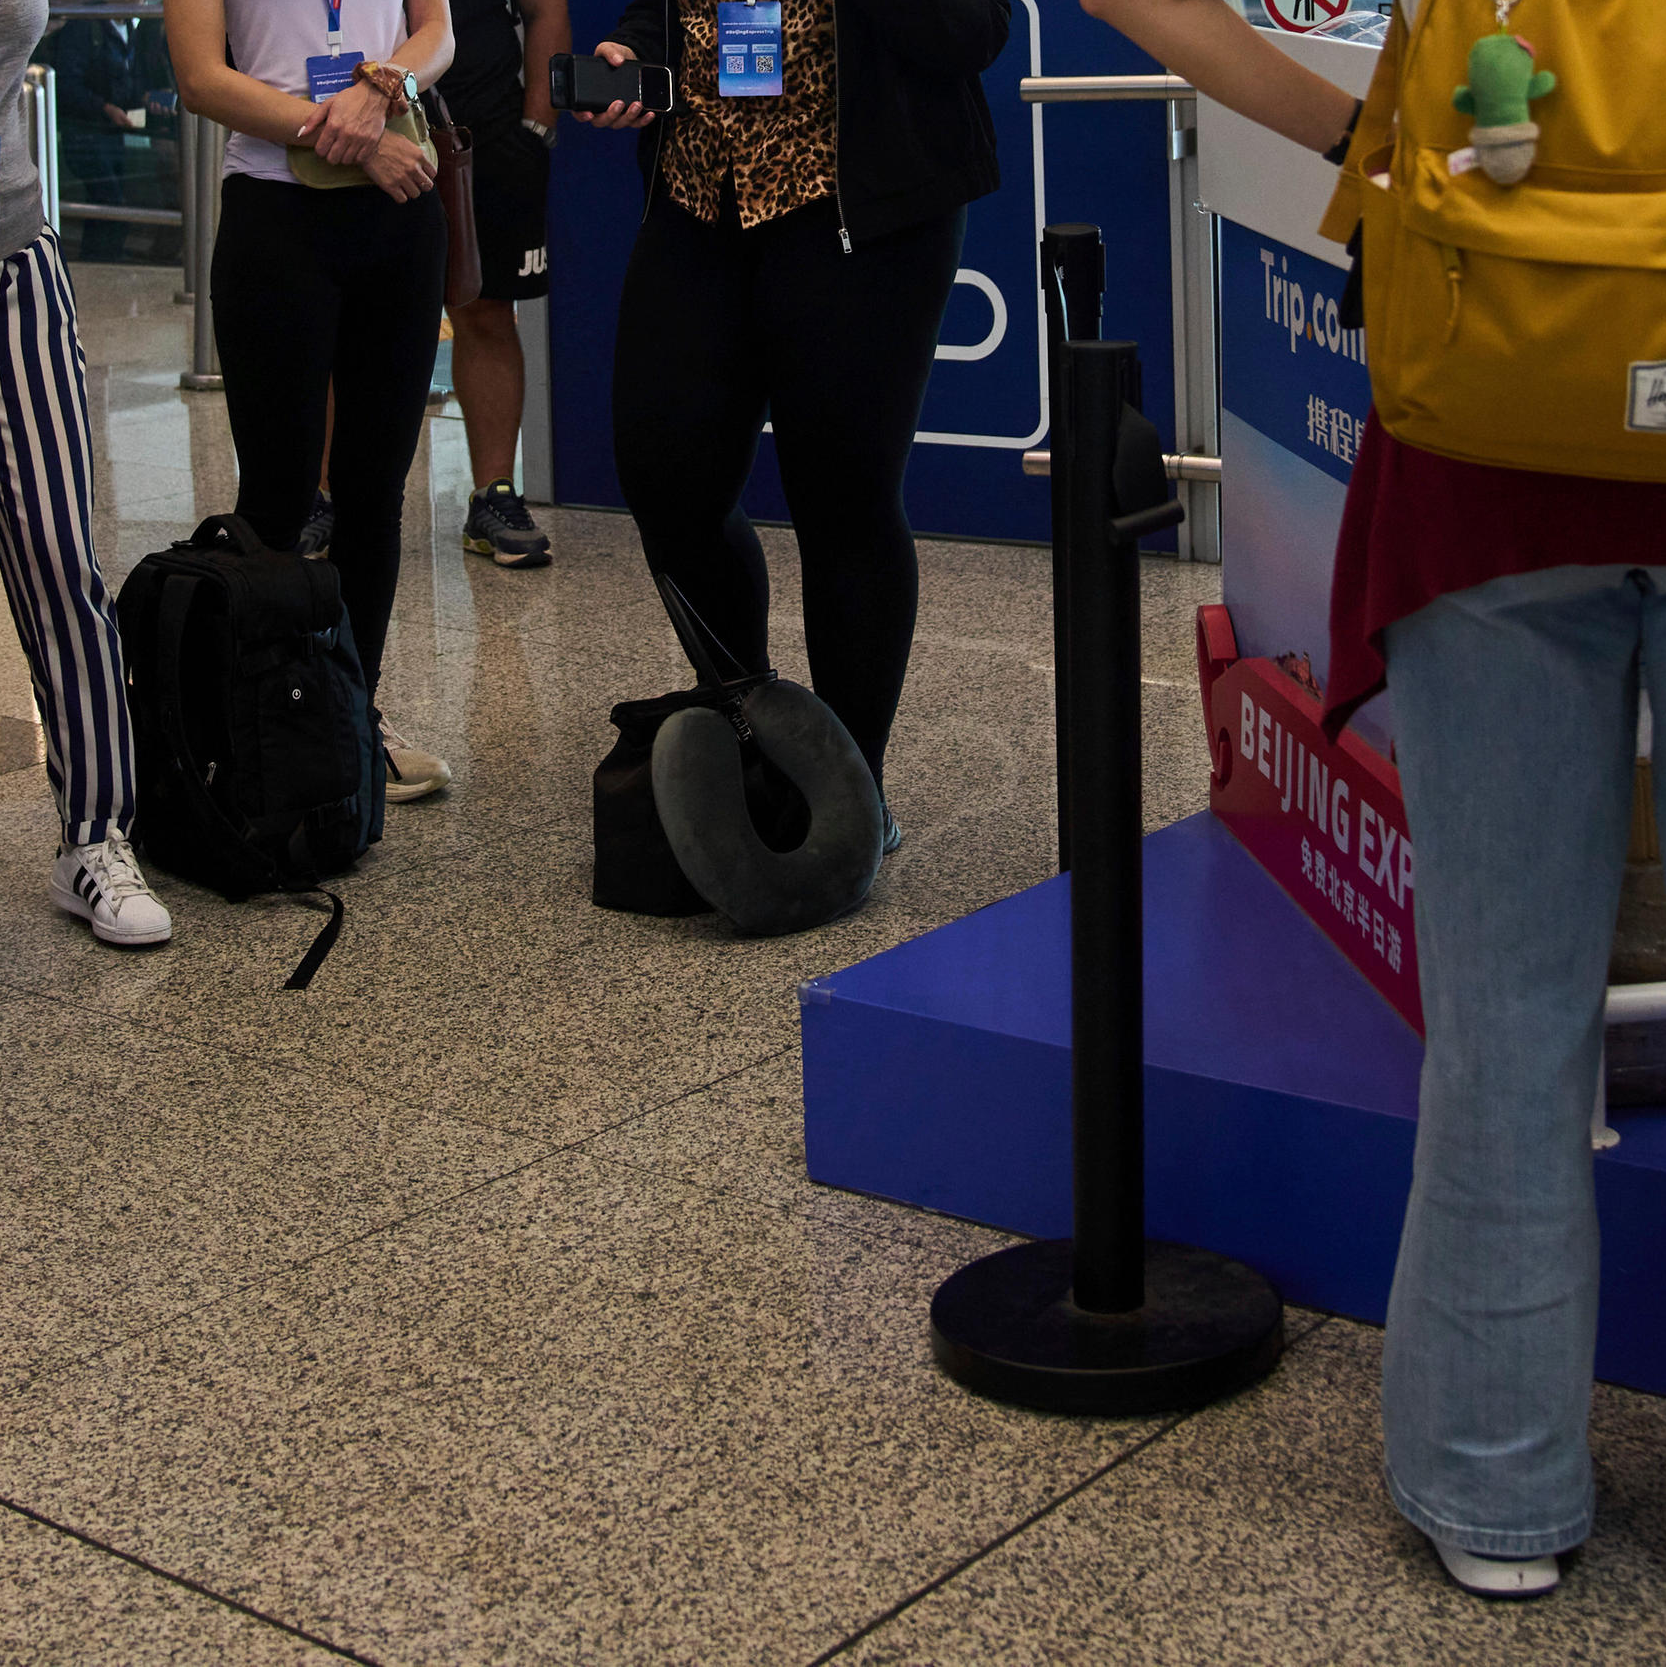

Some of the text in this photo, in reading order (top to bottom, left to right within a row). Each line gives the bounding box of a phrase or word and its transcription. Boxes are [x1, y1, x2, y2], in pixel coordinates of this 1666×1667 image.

[1239, 690, 1350, 855] BEIJING
[1299, 834, 1403, 975] 免费北京半日游
